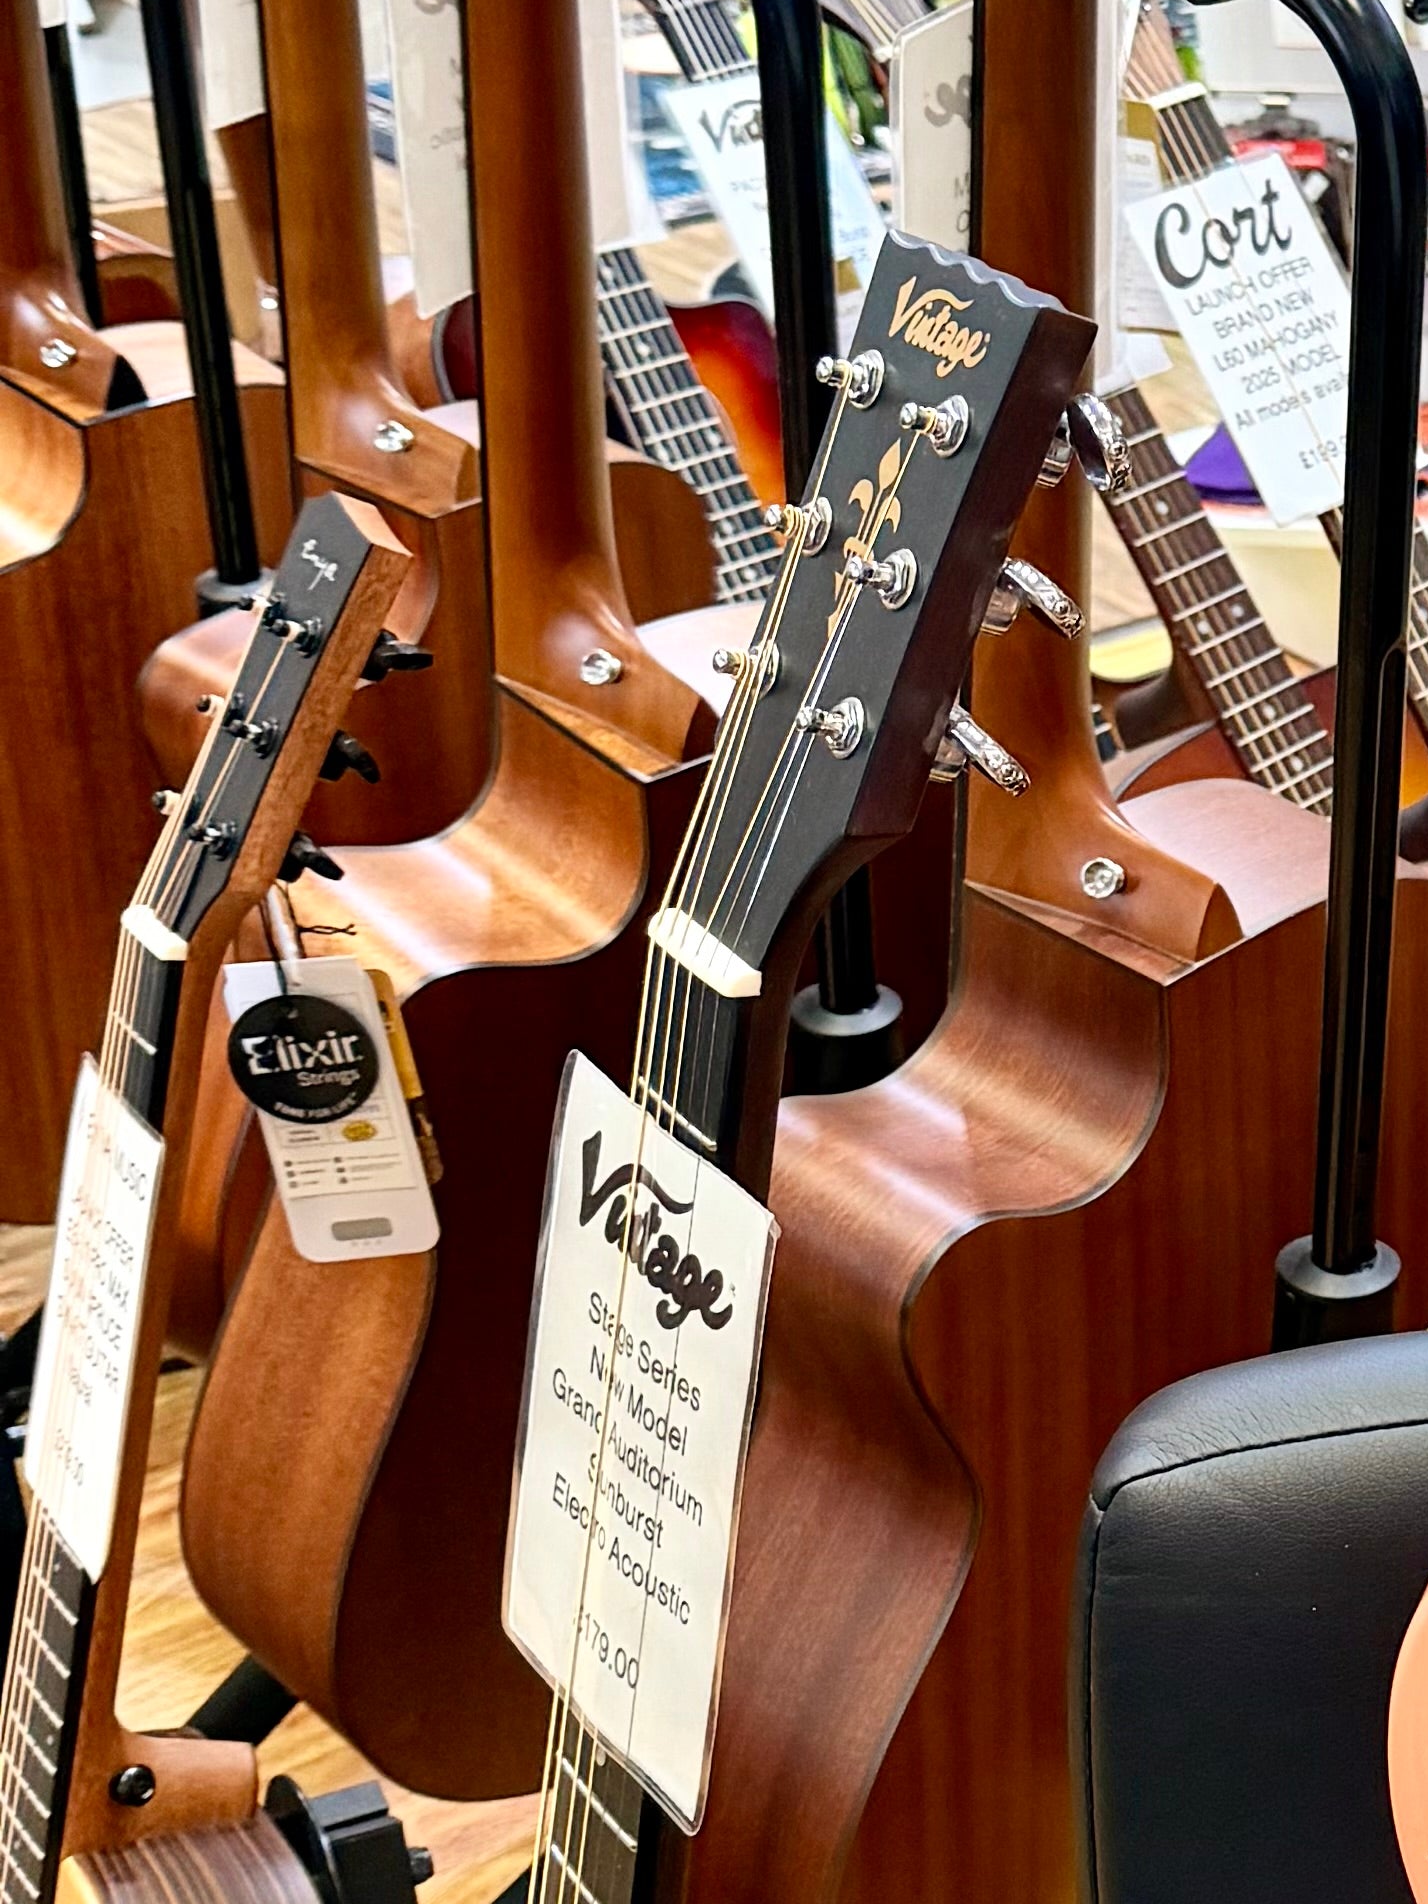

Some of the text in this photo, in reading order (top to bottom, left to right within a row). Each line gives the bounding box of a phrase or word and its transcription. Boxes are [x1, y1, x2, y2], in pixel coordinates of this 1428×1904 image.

[1154, 178, 1292, 290] Cort
[1184, 256, 1316, 317] LAUNCH OFFER
[1211, 287, 1317, 340] BRAND NEW
[888, 275, 992, 378] Vintage
[1248, 310, 1341, 360] MAHOGANY
[1240, 344, 1343, 395] 2025 MODEL
[1234, 392, 1313, 431] All models
[240, 1029, 364, 1076] Elixir
[297, 1068, 361, 1087] Strings
[578, 1129, 734, 1331] Vintage
[588, 1291, 702, 1412] Stage Series
[627, 1383, 689, 1457] Model
[587, 1452, 664, 1549] Sunburst
[607, 1420, 704, 1527] Auditorium
[551, 1471, 691, 1627] Elecro Acoustic
[575, 1608, 640, 1690] 179.00
